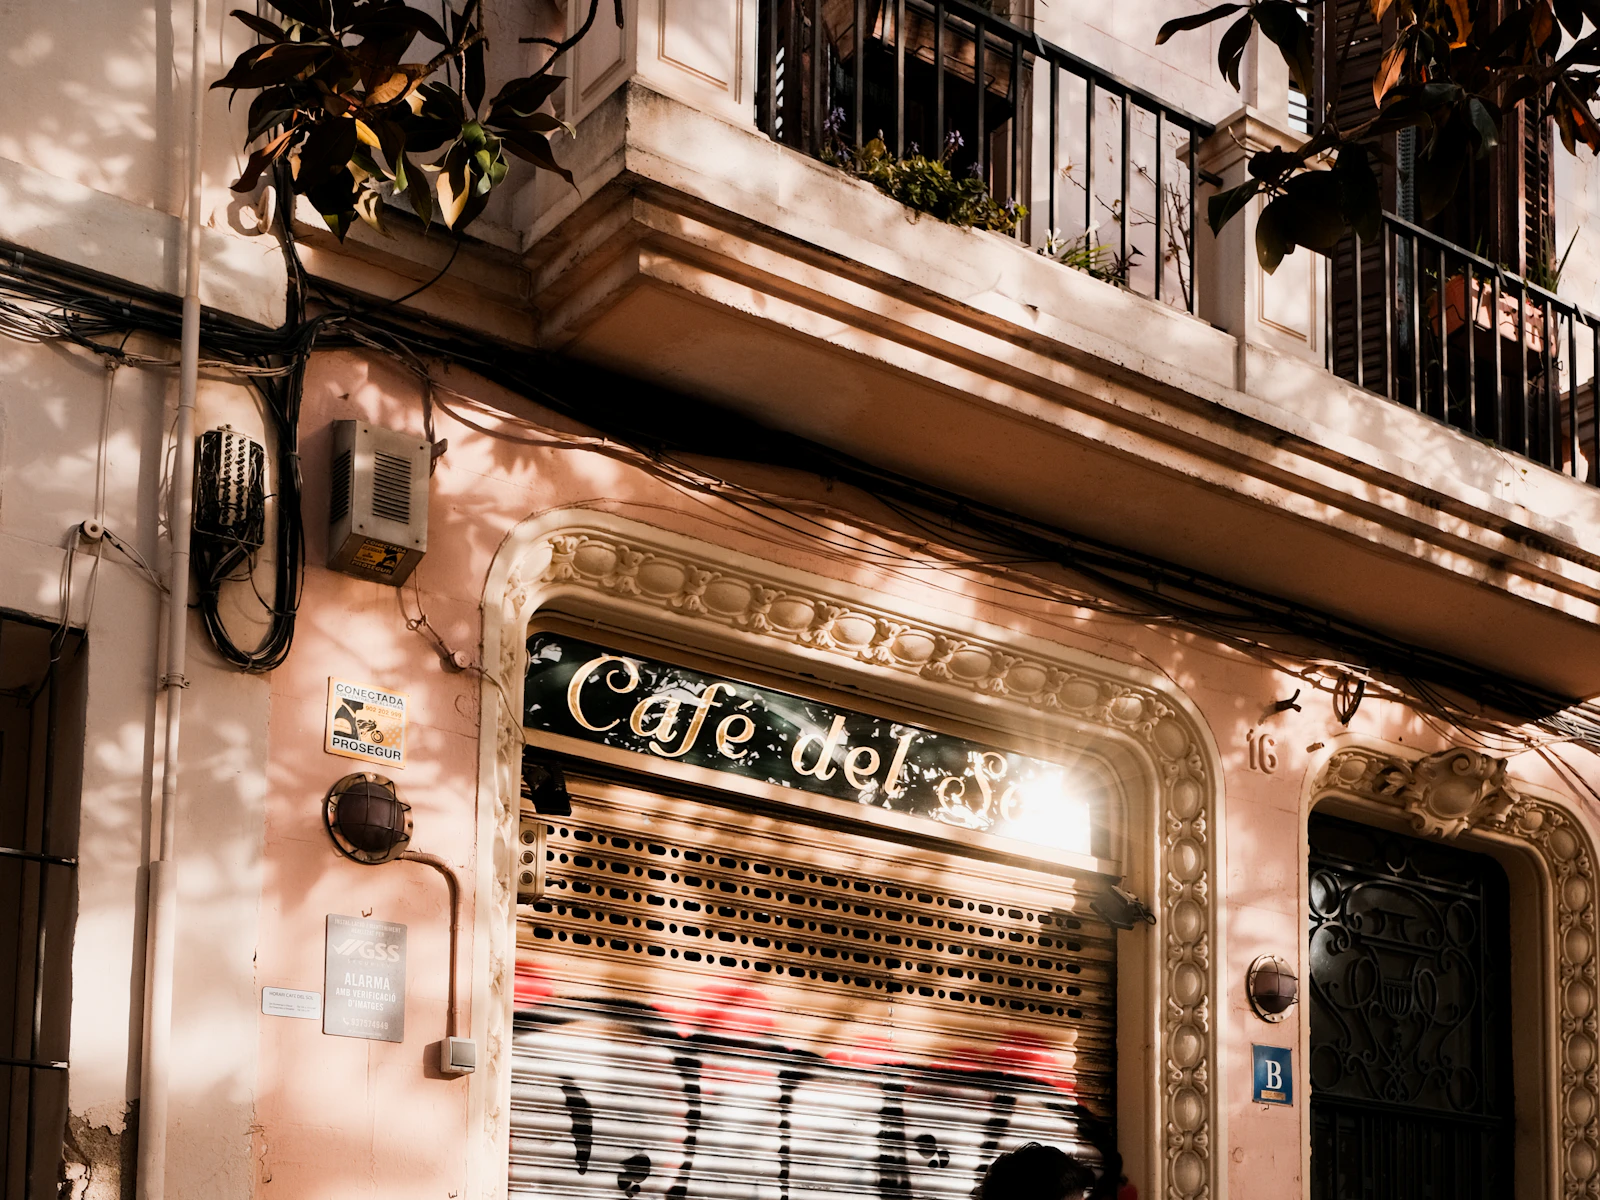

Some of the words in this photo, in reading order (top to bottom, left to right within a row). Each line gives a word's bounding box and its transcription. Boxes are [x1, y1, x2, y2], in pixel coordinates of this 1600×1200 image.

[365, 539, 407, 554] CONECTADA
[351, 560, 393, 575] PROSEGUR
[336, 683, 404, 707] CONECTADA
[365, 705, 377, 713] 902
[378, 708, 390, 716] 202
[379, 701, 404, 711] ALARMAS
[567, 655, 756, 758] Café
[790, 714, 913, 796] del
[332, 737, 401, 761] PROSEGUR
[1246, 728, 1278, 775] 16
[358, 940, 400, 963] GSS
[344, 972, 390, 991] ALARMA
[335, 987, 351, 997] AMB
[352, 988, 396, 1003] VERIFICACIÓ
[348, 999, 384, 1011] D'IMATGES
[1265, 1059, 1283, 1090] B
